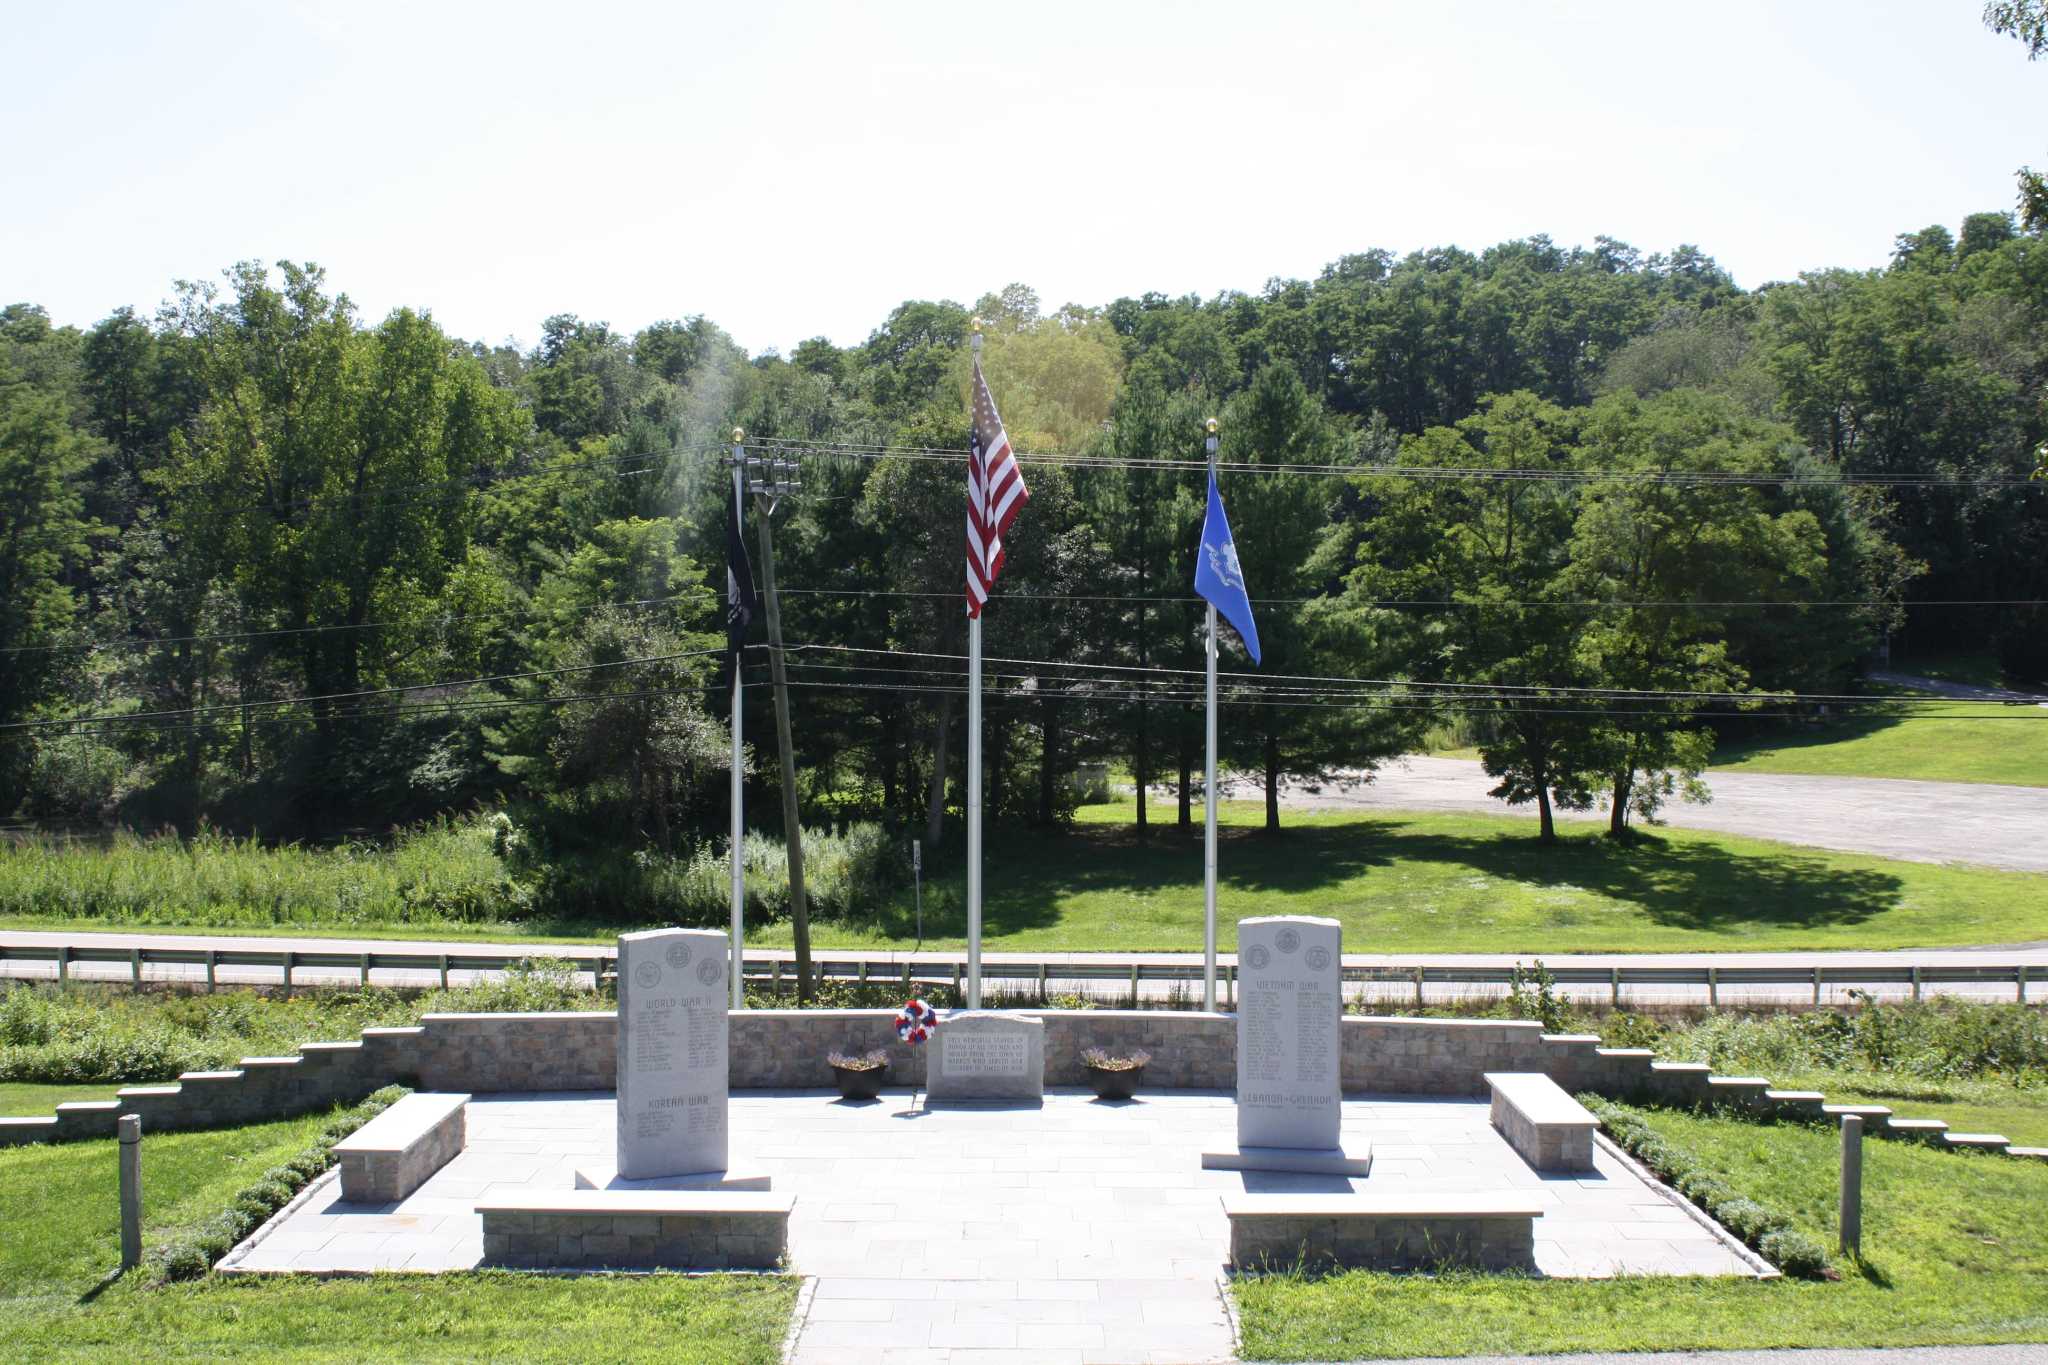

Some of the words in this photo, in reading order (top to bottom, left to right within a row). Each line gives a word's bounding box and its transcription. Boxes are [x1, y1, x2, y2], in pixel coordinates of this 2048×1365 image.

[646, 1000, 676, 1009] WORLD
[681, 999, 700, 1008] WAR
[648, 1098, 684, 1109] KOREAN
[689, 1096, 709, 1105] WAR
